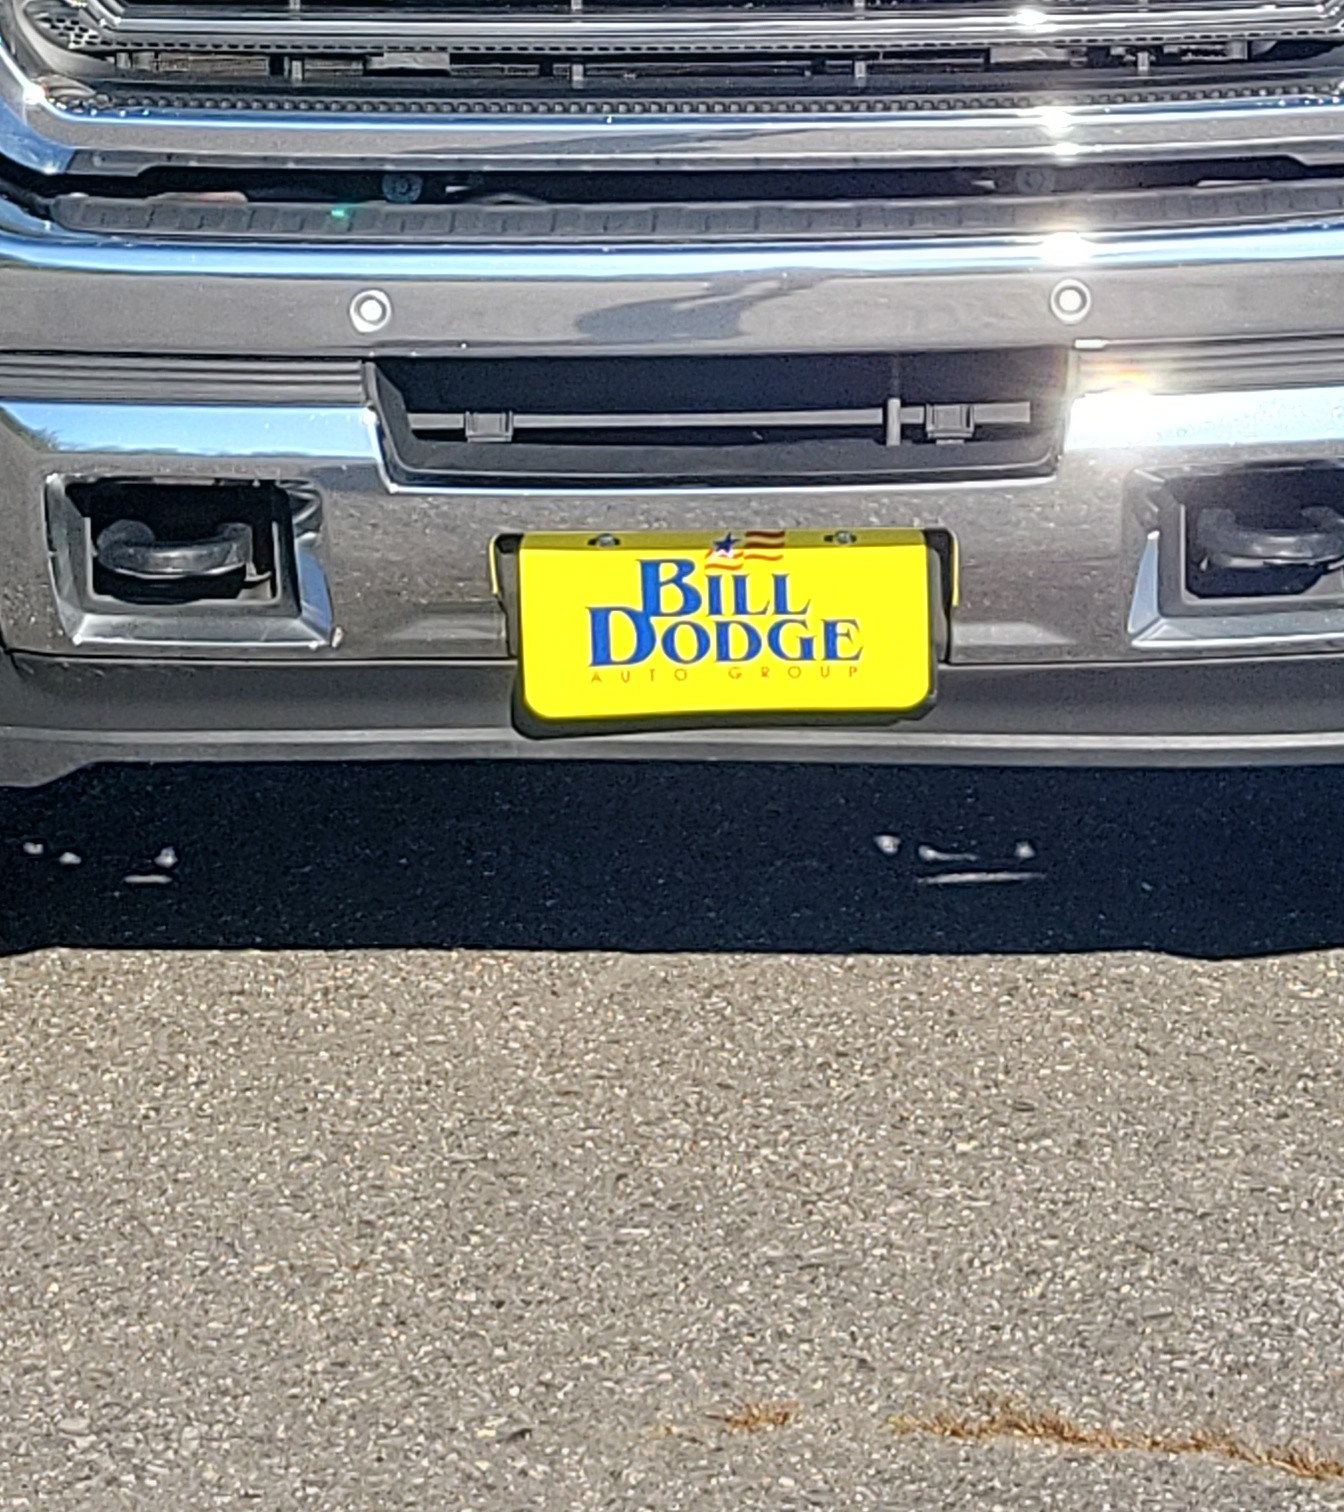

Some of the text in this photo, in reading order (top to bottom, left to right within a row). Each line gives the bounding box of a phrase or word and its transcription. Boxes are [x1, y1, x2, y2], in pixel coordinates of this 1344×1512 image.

[636, 558, 812, 617] BILL
[585, 605, 864, 667] DODGE
[589, 665, 860, 683] AUTO GROUP
